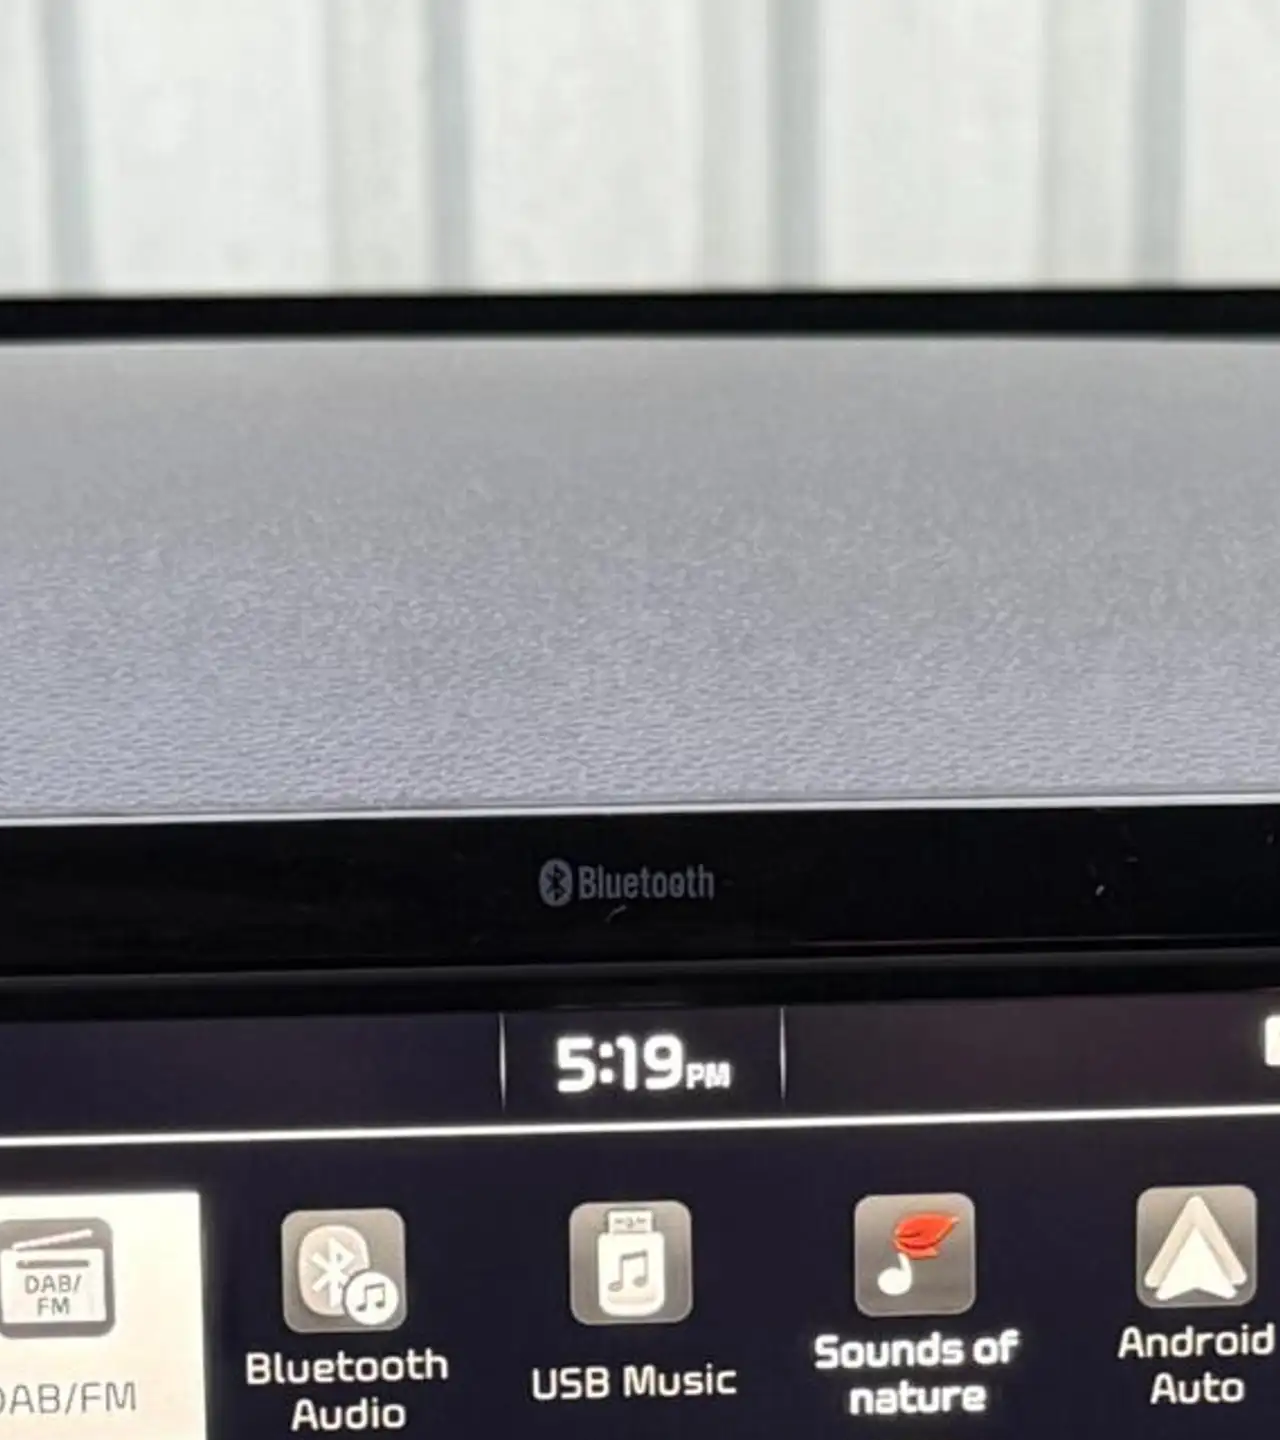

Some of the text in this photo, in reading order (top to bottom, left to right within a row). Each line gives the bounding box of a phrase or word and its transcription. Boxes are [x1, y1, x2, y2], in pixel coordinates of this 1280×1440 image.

[578, 863, 715, 900] Bluetooth
[37, 1295, 71, 1317] FM
[814, 1329, 1020, 1370] Sounds of
[1118, 1324, 1276, 1359] Android
[245, 1349, 448, 1386] Bluetooth
[532, 1362, 737, 1401] USB Music
[848, 1382, 987, 1417] nature
[1149, 1371, 1245, 1405] Auto
[291, 1396, 407, 1431] Audio
